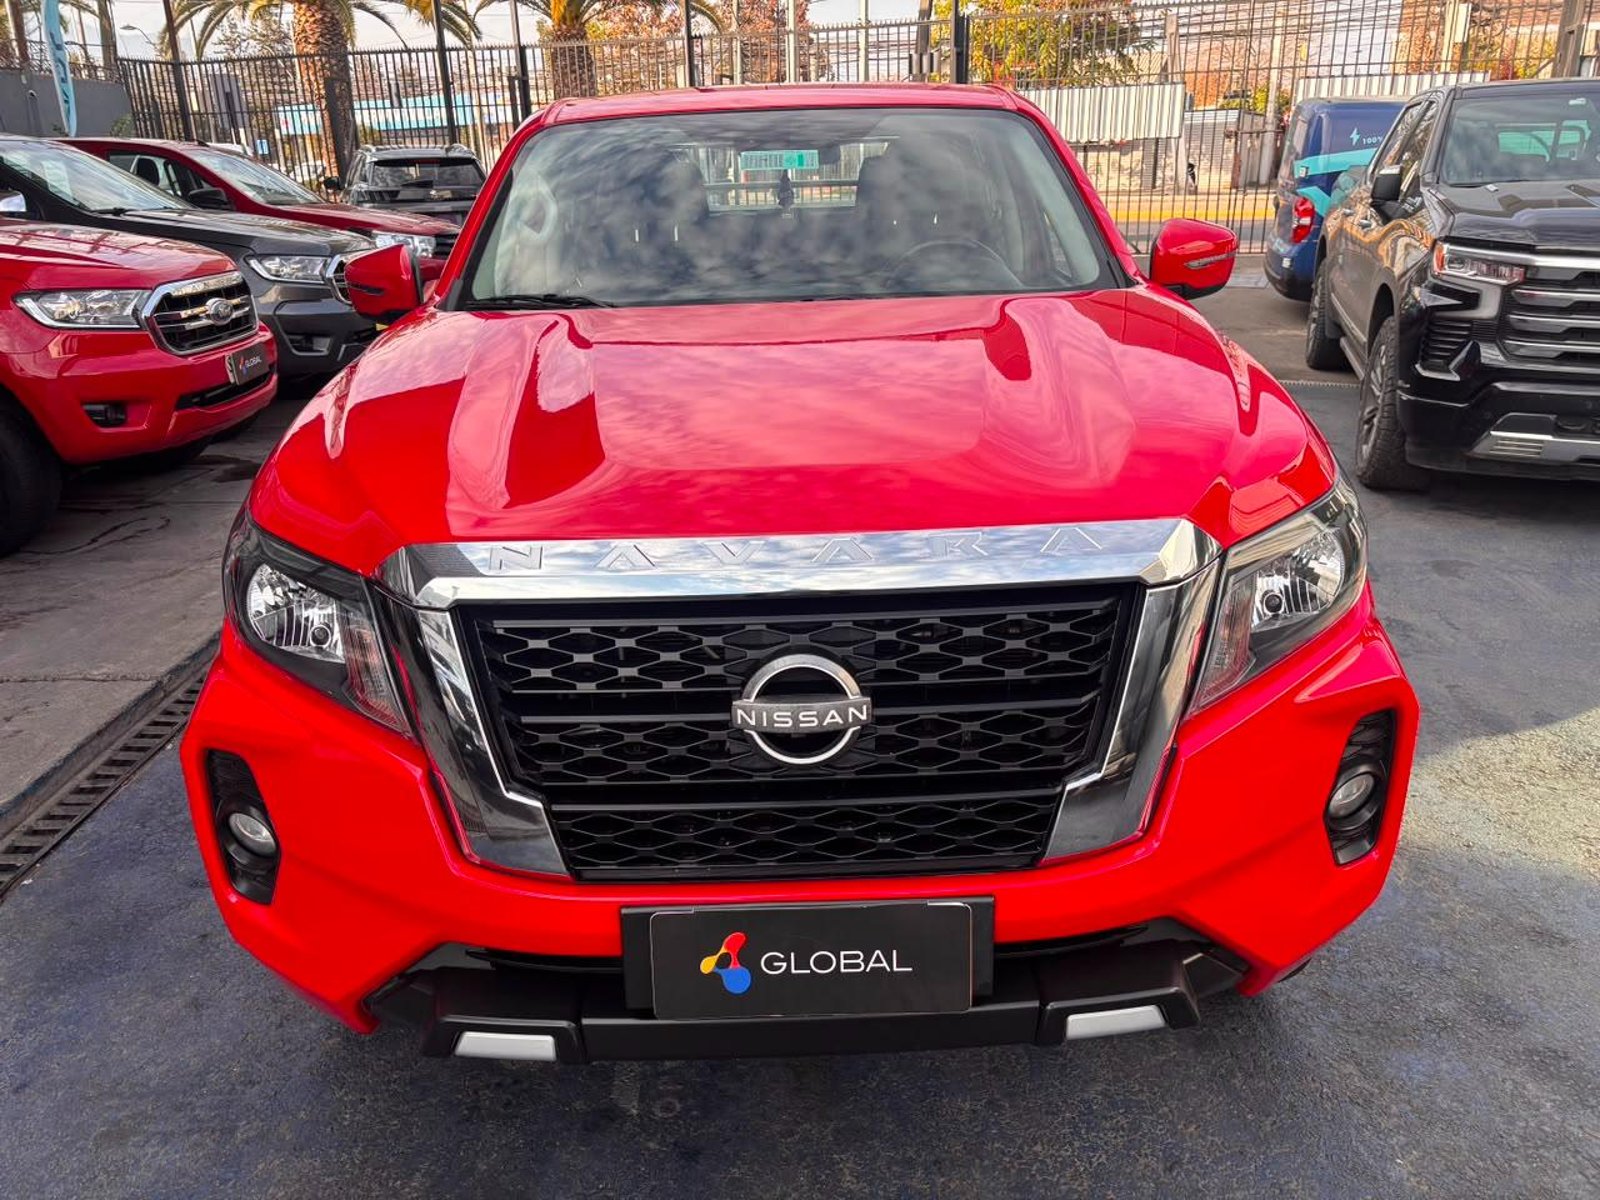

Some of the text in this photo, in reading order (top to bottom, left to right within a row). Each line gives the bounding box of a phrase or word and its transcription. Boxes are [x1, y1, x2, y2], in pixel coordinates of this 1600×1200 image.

[488, 527, 1102, 571] NAVARA
[736, 704, 867, 727] NISSAN
[760, 949, 913, 975] GLOBAL
